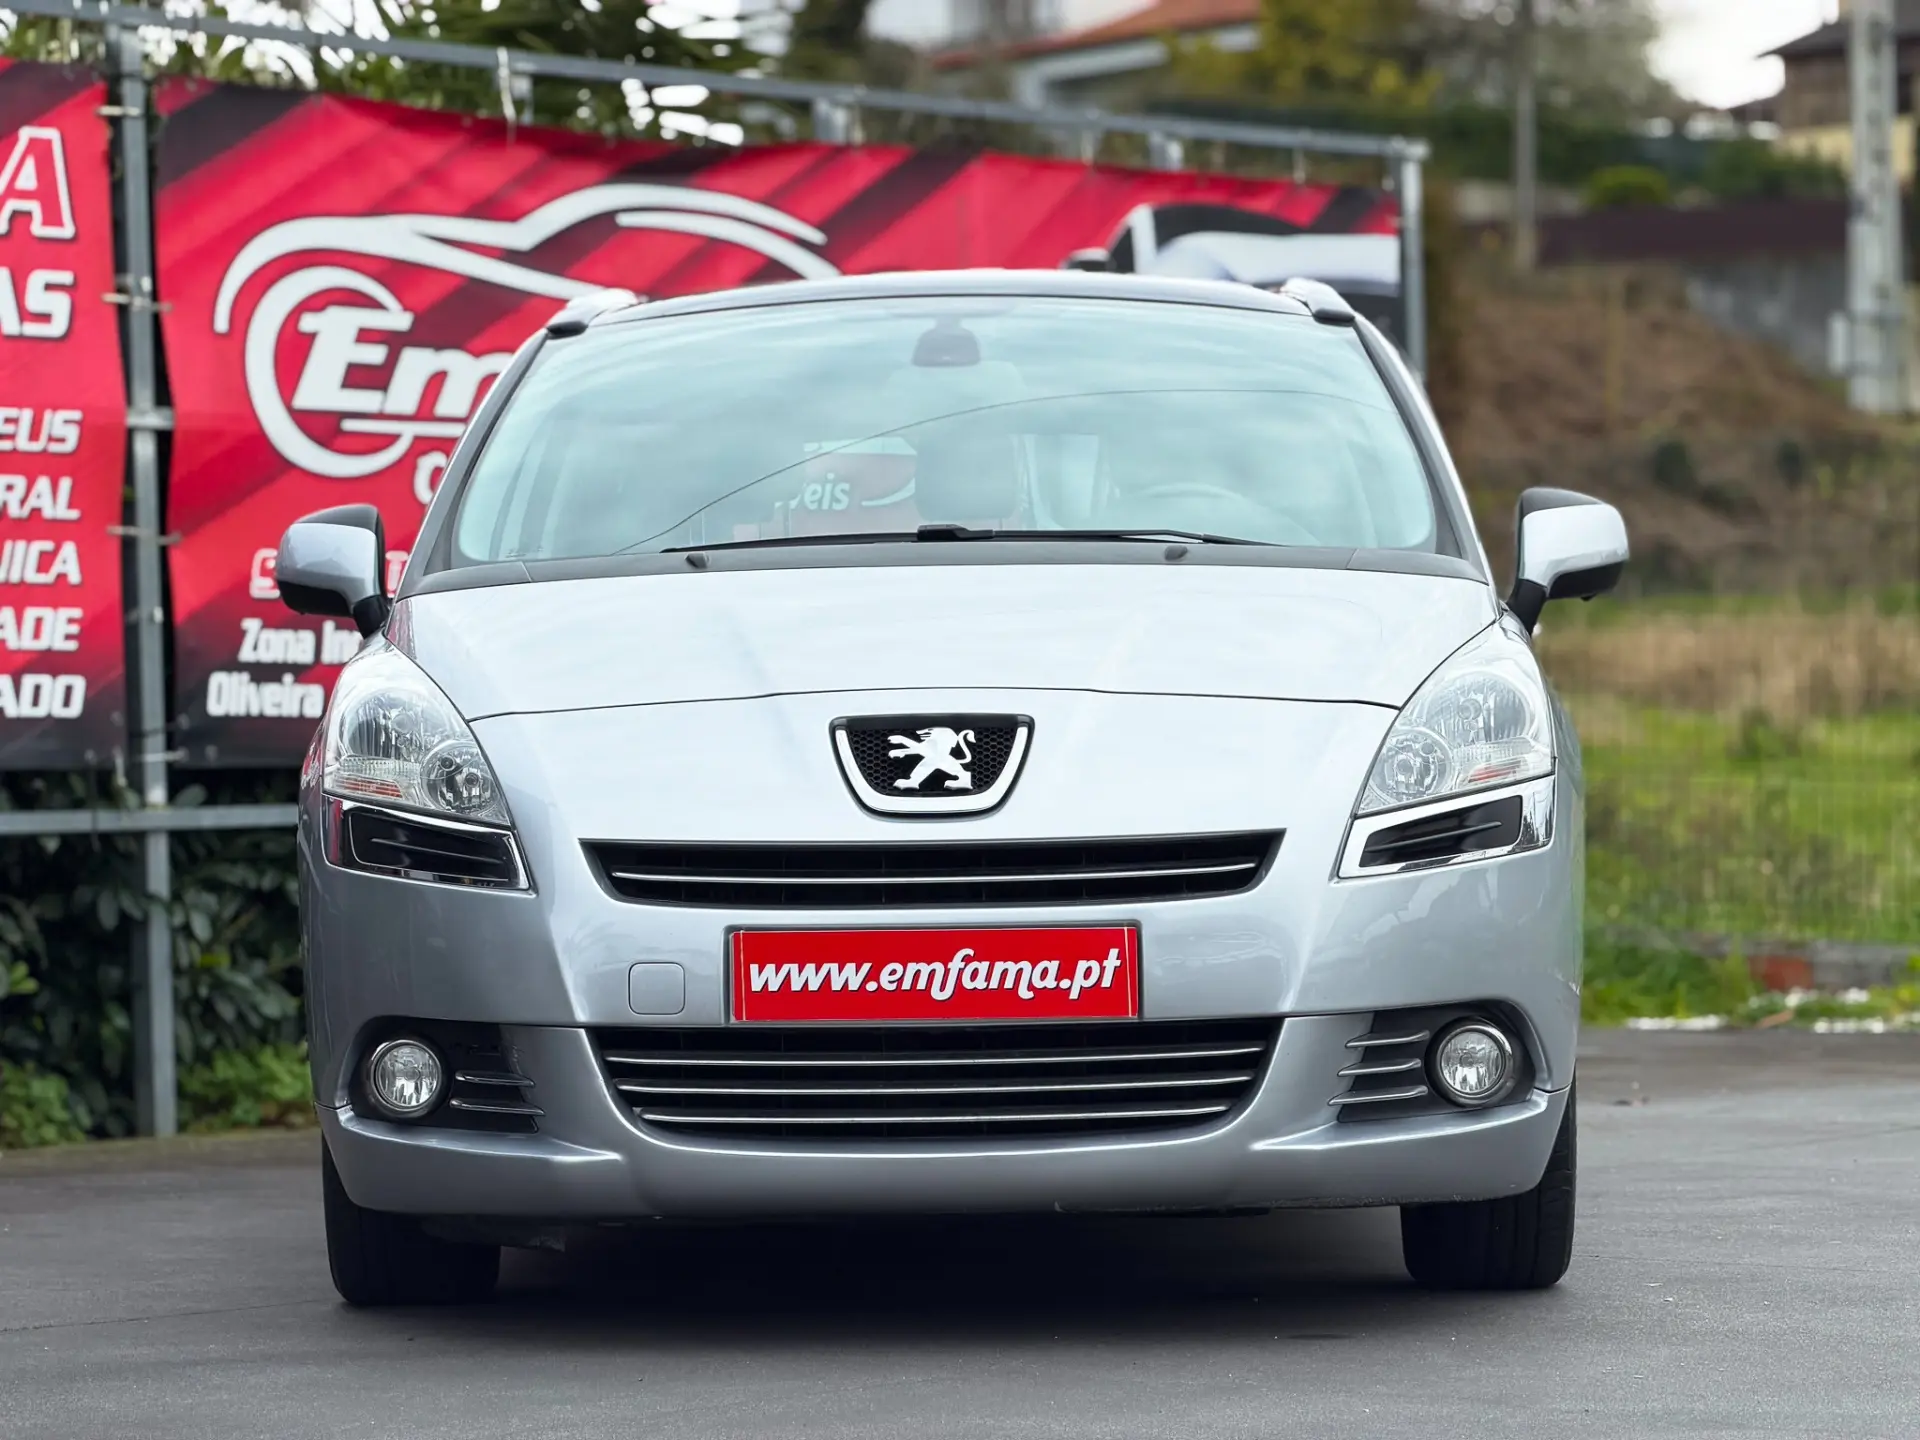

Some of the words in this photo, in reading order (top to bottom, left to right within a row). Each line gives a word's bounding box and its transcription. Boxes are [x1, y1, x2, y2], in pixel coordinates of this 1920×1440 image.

[0, 473, 82, 521] RAL
[237, 617, 316, 665] Zona
[206, 670, 325, 718] Oliveira
[749, 948, 1121, 1001] www.emfama.pt
